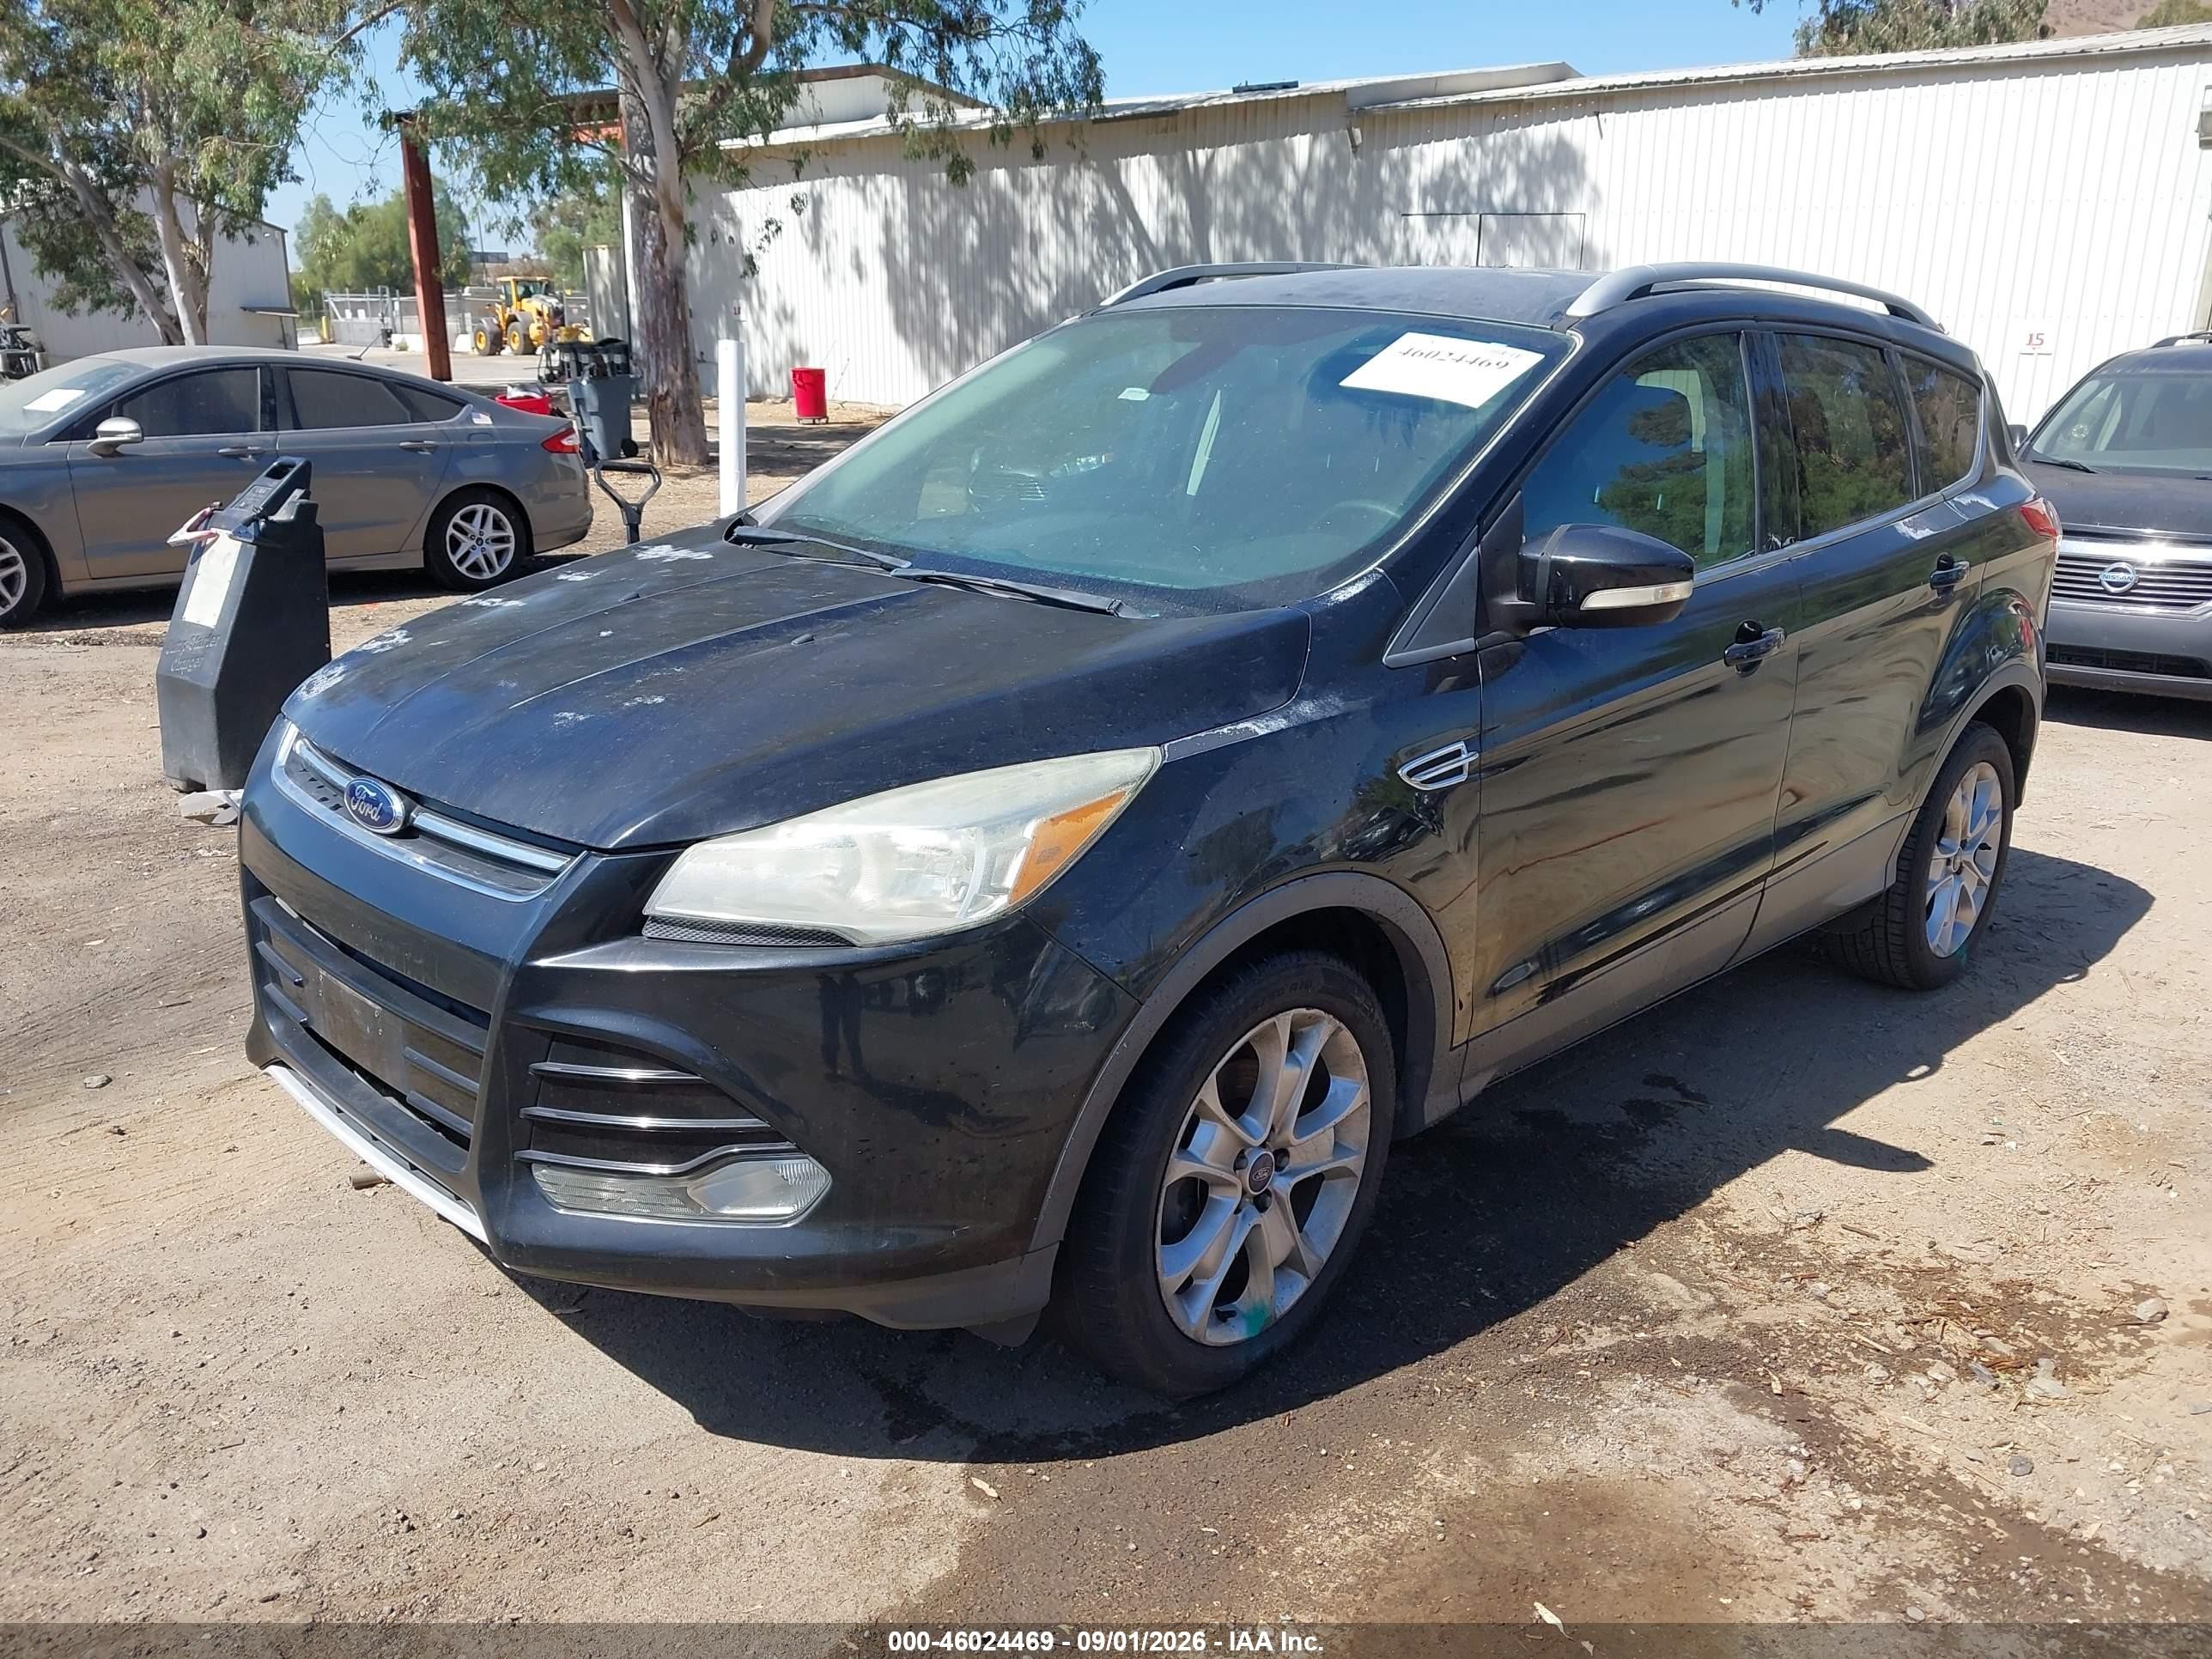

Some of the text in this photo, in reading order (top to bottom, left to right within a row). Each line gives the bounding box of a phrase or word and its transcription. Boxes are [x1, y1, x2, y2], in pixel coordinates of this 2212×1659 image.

[2026, 332, 2045, 346] 15
[2102, 574, 2134, 582] NISSAN
[350, 784, 384, 822] Ford
